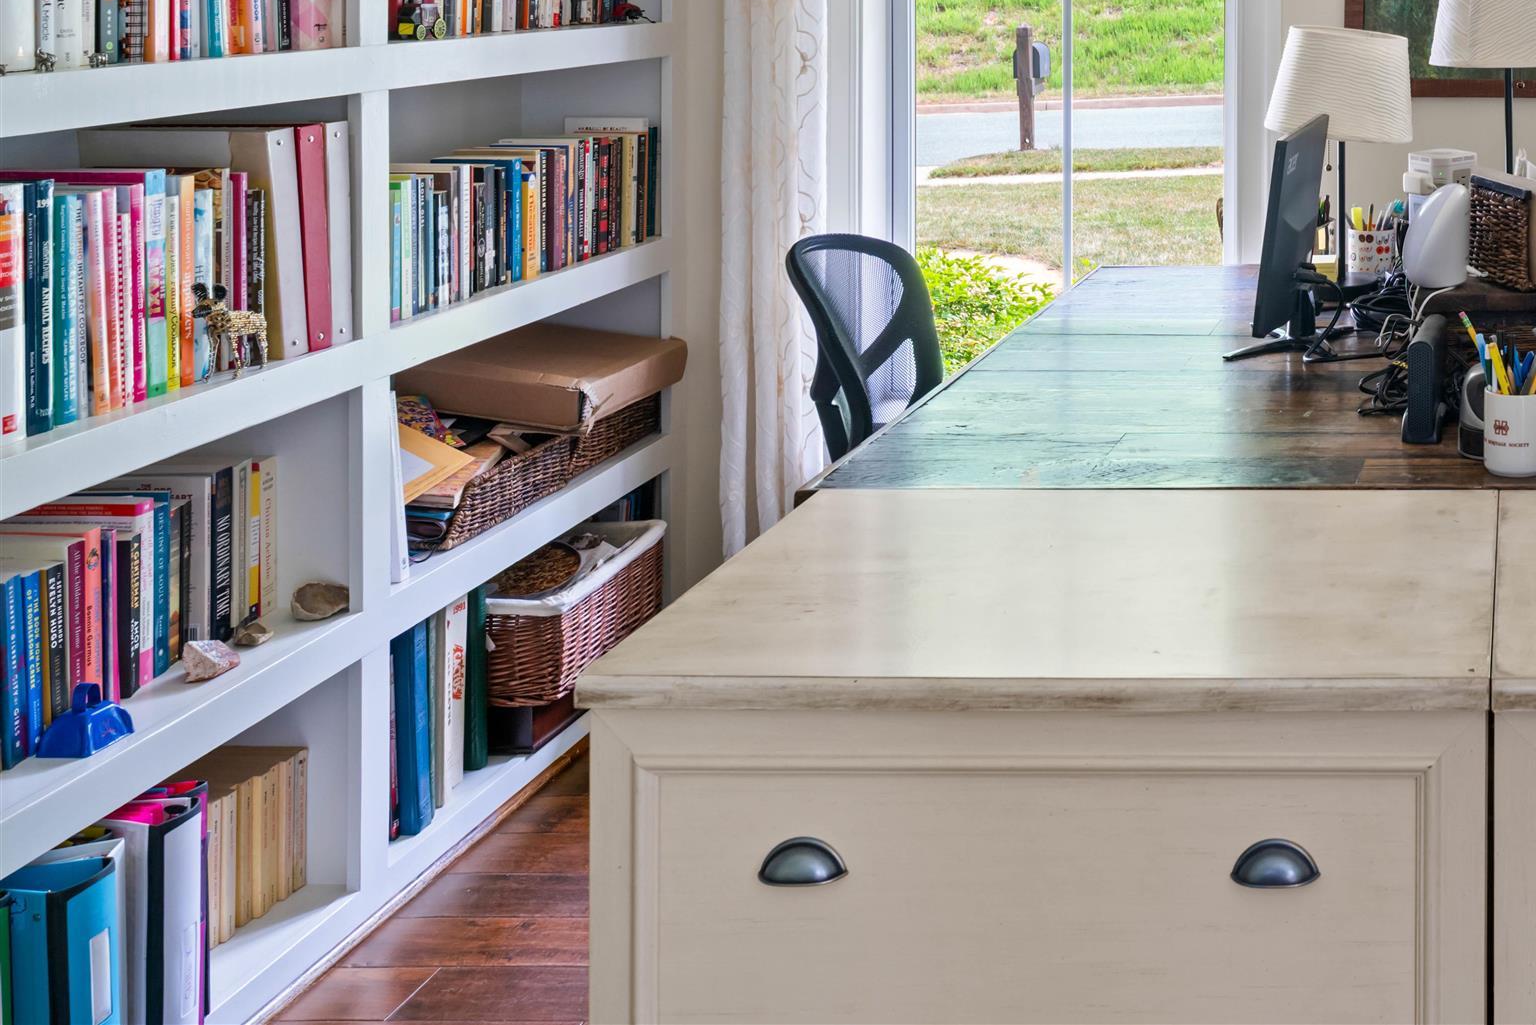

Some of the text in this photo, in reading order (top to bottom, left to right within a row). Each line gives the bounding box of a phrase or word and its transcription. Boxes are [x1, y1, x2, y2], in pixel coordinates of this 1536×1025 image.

[42, 9, 50, 41] Miracle
[41, 287, 51, 365] ANNUAL RECIPES
[265, 498, 273, 538] Chinua
[73, 549, 81, 560] All
[158, 557, 165, 571] OF
[216, 514, 231, 620] NO ORDINARY TIME
[27, 589, 33, 603] OF
[74, 576, 82, 609] Children
[7, 585, 18, 670] ELIZABETH GILBERT
[48, 577, 58, 649] EVELYN HUGO
[27, 605, 35, 661] TROUBLESOME
[74, 625, 82, 649] Home
[12, 674, 20, 695] CITY
[13, 708, 22, 736] GIRLS
